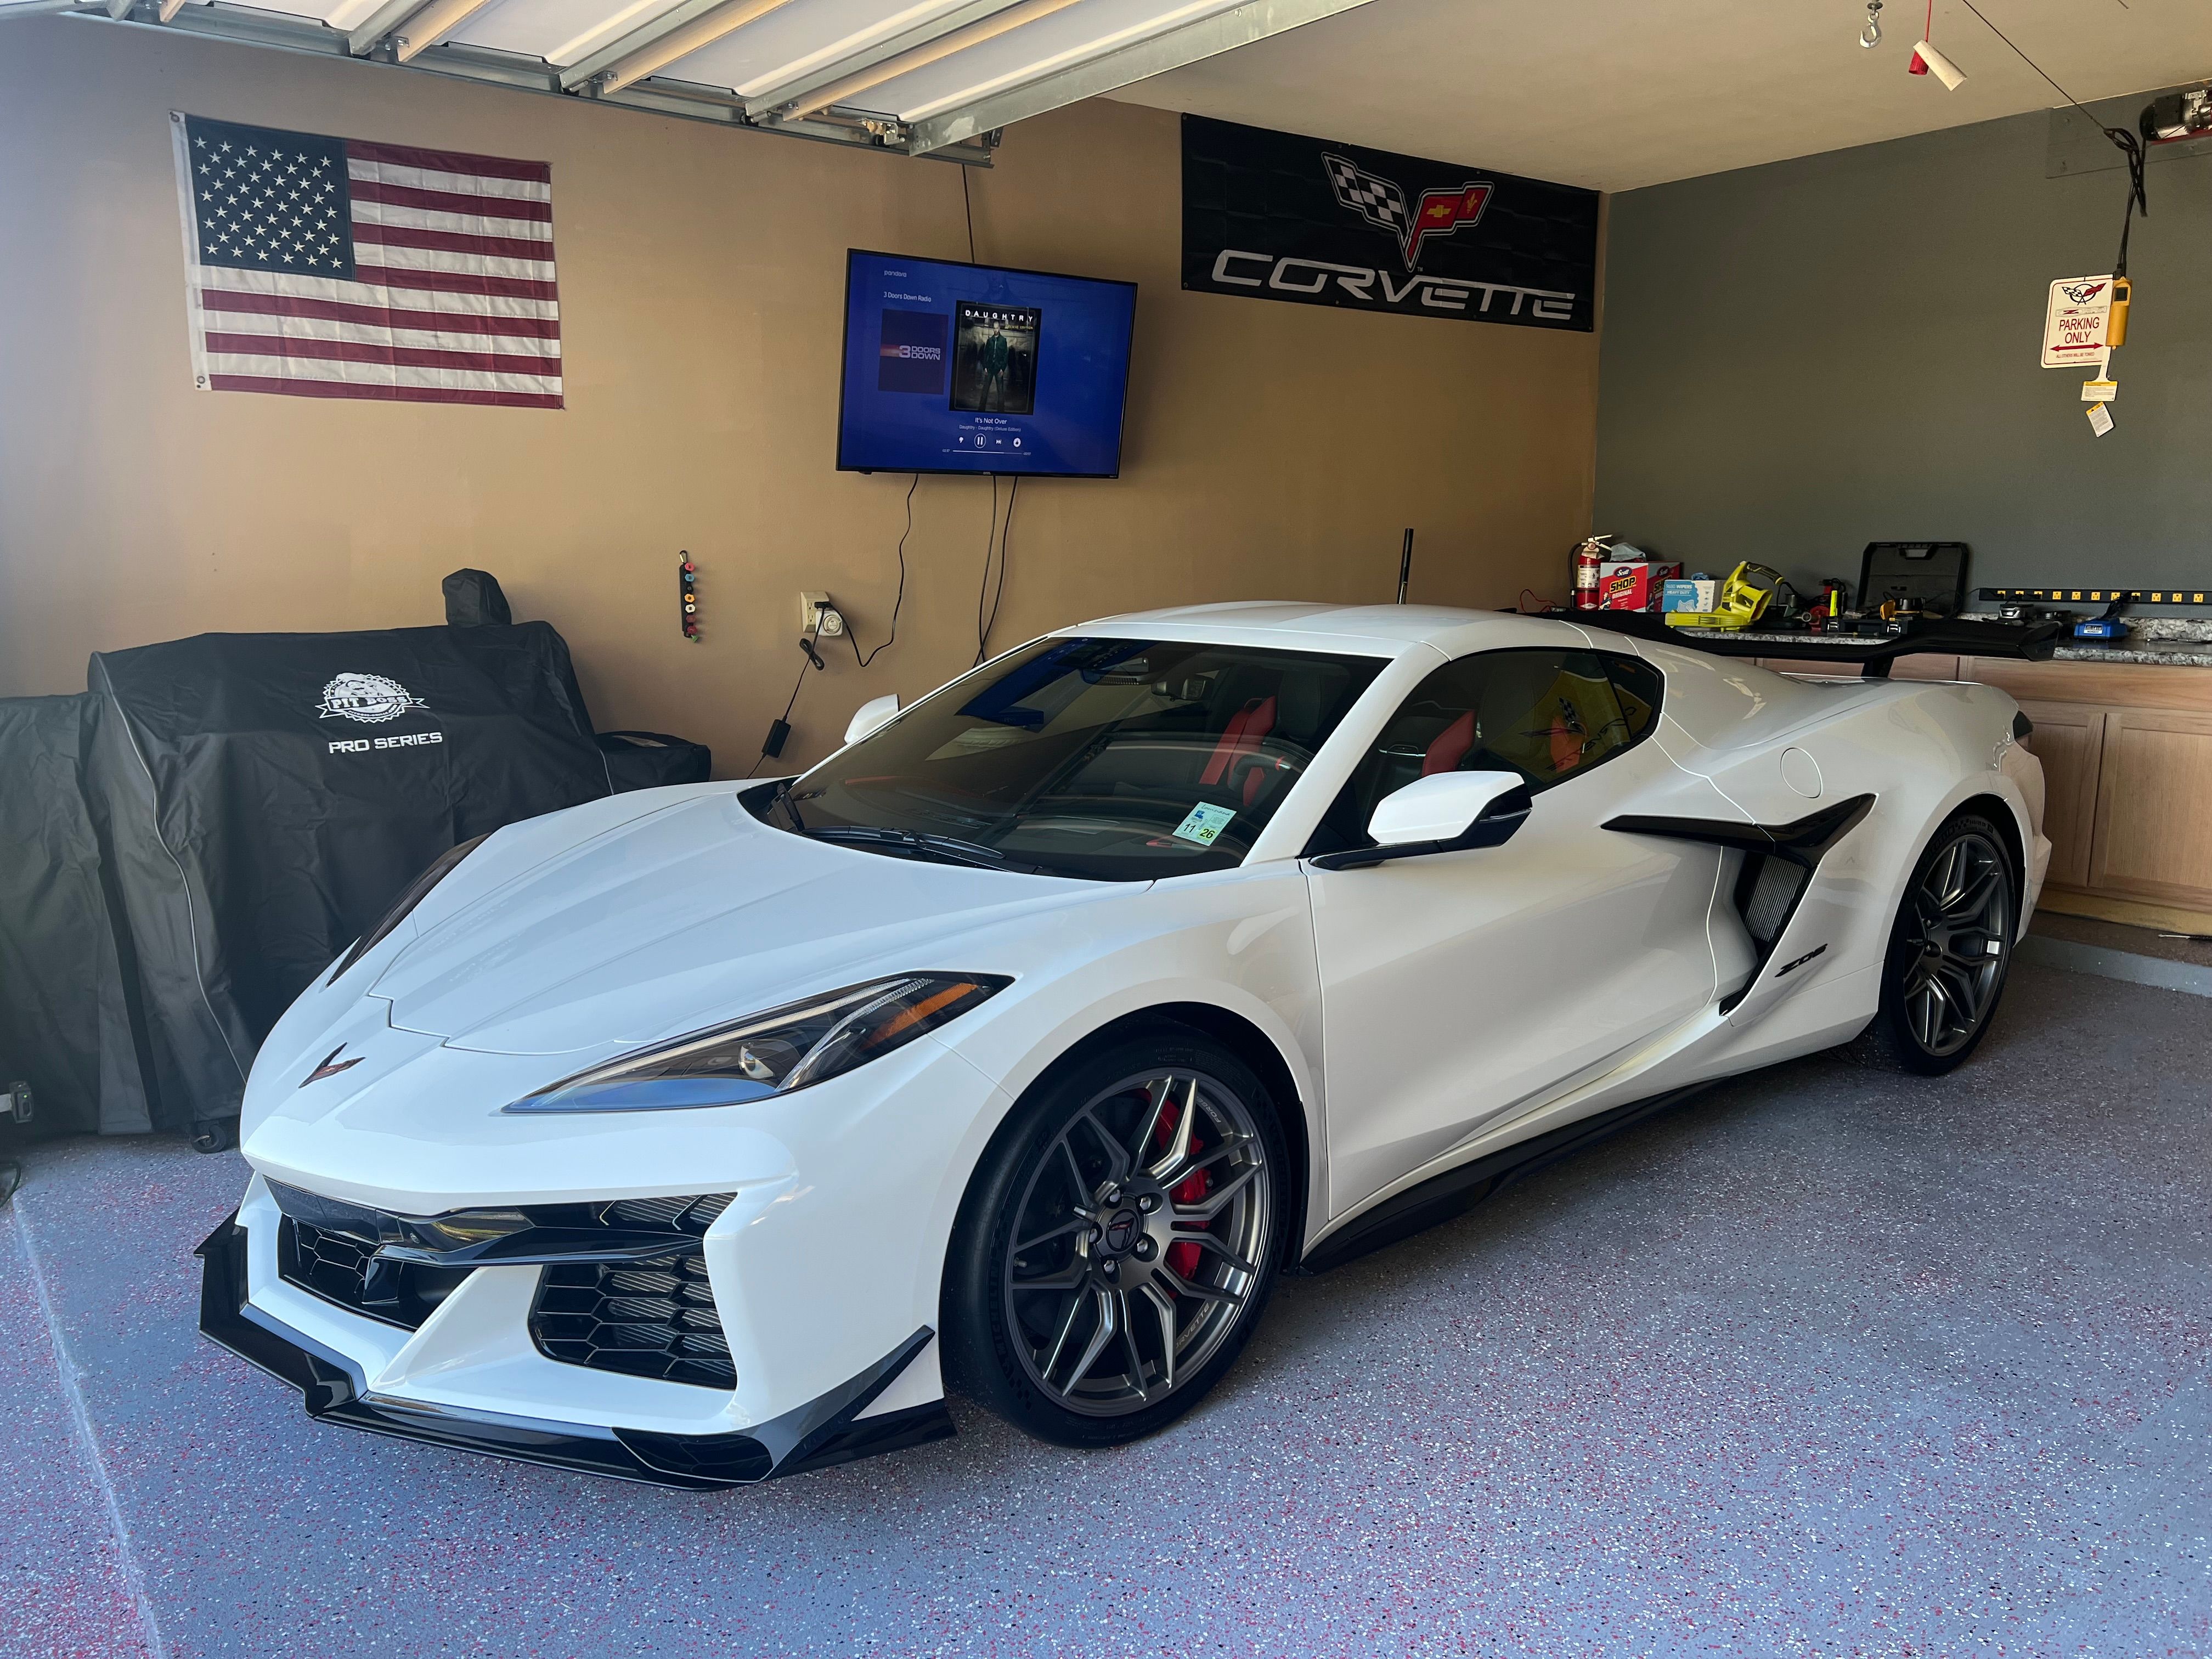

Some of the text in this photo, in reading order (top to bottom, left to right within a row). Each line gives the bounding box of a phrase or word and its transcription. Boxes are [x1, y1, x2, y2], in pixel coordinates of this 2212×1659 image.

[1211, 249, 1576, 320] CORVETTE
[965, 309, 1033, 322] DAUGHTRY
[2059, 317, 2100, 331] PARKING
[2065, 331, 2091, 343] ONLY
[899, 345, 911, 358] 3
[911, 352, 940, 360] DOWN
[1610, 577, 1636, 592] SHOP
[1612, 589, 1633, 599] ORIGINAL
[330, 696, 408, 709] PIT BOSS
[329, 732, 443, 754] PRO SERIES
[1201, 804, 1231, 816] Louisiana
[1184, 823, 1197, 833] 11
[1199, 828, 1215, 839] 26
[1197, 1096, 1222, 1124] FORGE
[1176, 1302, 1210, 1349] RVETTE
